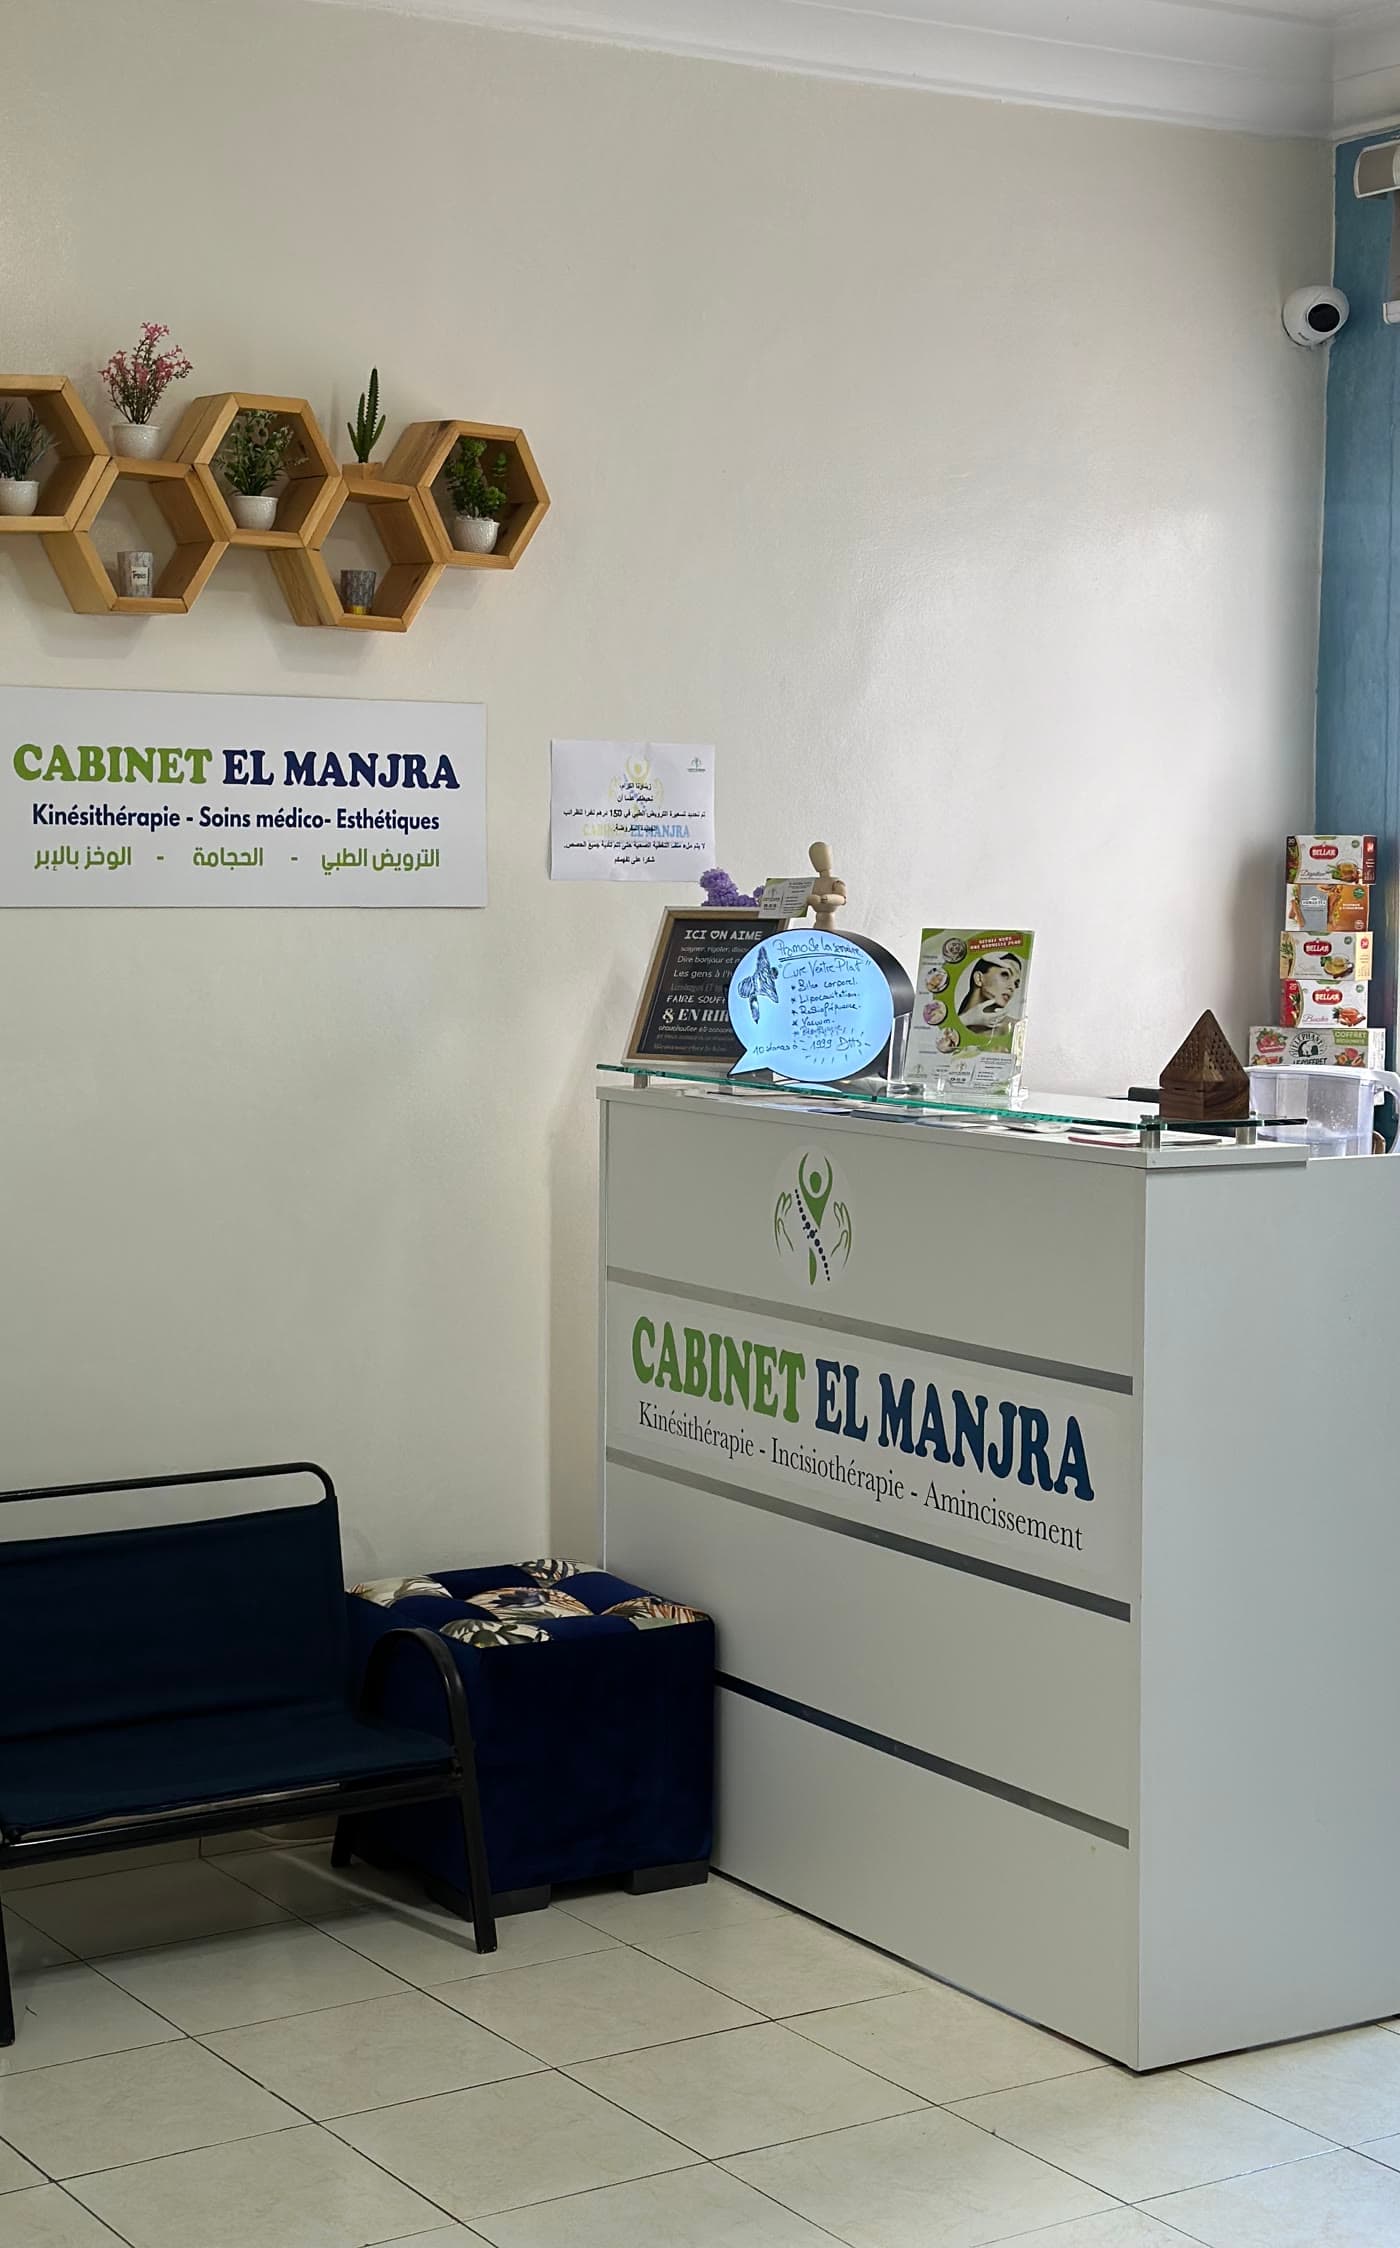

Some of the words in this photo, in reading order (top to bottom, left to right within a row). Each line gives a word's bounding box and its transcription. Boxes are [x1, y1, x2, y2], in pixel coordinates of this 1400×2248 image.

[13, 744, 213, 785] CABINET
[222, 749, 274, 786] EL
[283, 751, 460, 789] MANJRA
[32, 803, 181, 832] Kinésithérapie
[199, 806, 251, 828] Soins
[256, 807, 331, 830] médico-
[336, 807, 440, 835] Esthétiques
[610, 809, 622, 818] 150
[84, 846, 132, 871] الوخز
[193, 846, 264, 868] الحجامة
[321, 847, 368, 875] الطبي
[372, 847, 440, 872] الترويض
[684, 929, 707, 940] ICI
[730, 930, 763, 940] AIME
[820, 936, 832, 952] la
[677, 955, 693, 964] Dire
[695, 955, 723, 965] bonjour
[673, 969, 689, 978] Les
[691, 970, 712, 979] gens
[666, 994, 695, 1004] FAIRE
[662, 1007, 674, 1024] &
[678, 1008, 700, 1022] EN
[631, 1315, 806, 1424] CABINET
[815, 1358, 869, 1442] EL
[878, 1372, 1096, 1502] MANJRA
[638, 1400, 755, 1460] Kinésithérapie
[770, 1437, 905, 1502] Incisiothérapie
[923, 1481, 1084, 1552] Amincissement
